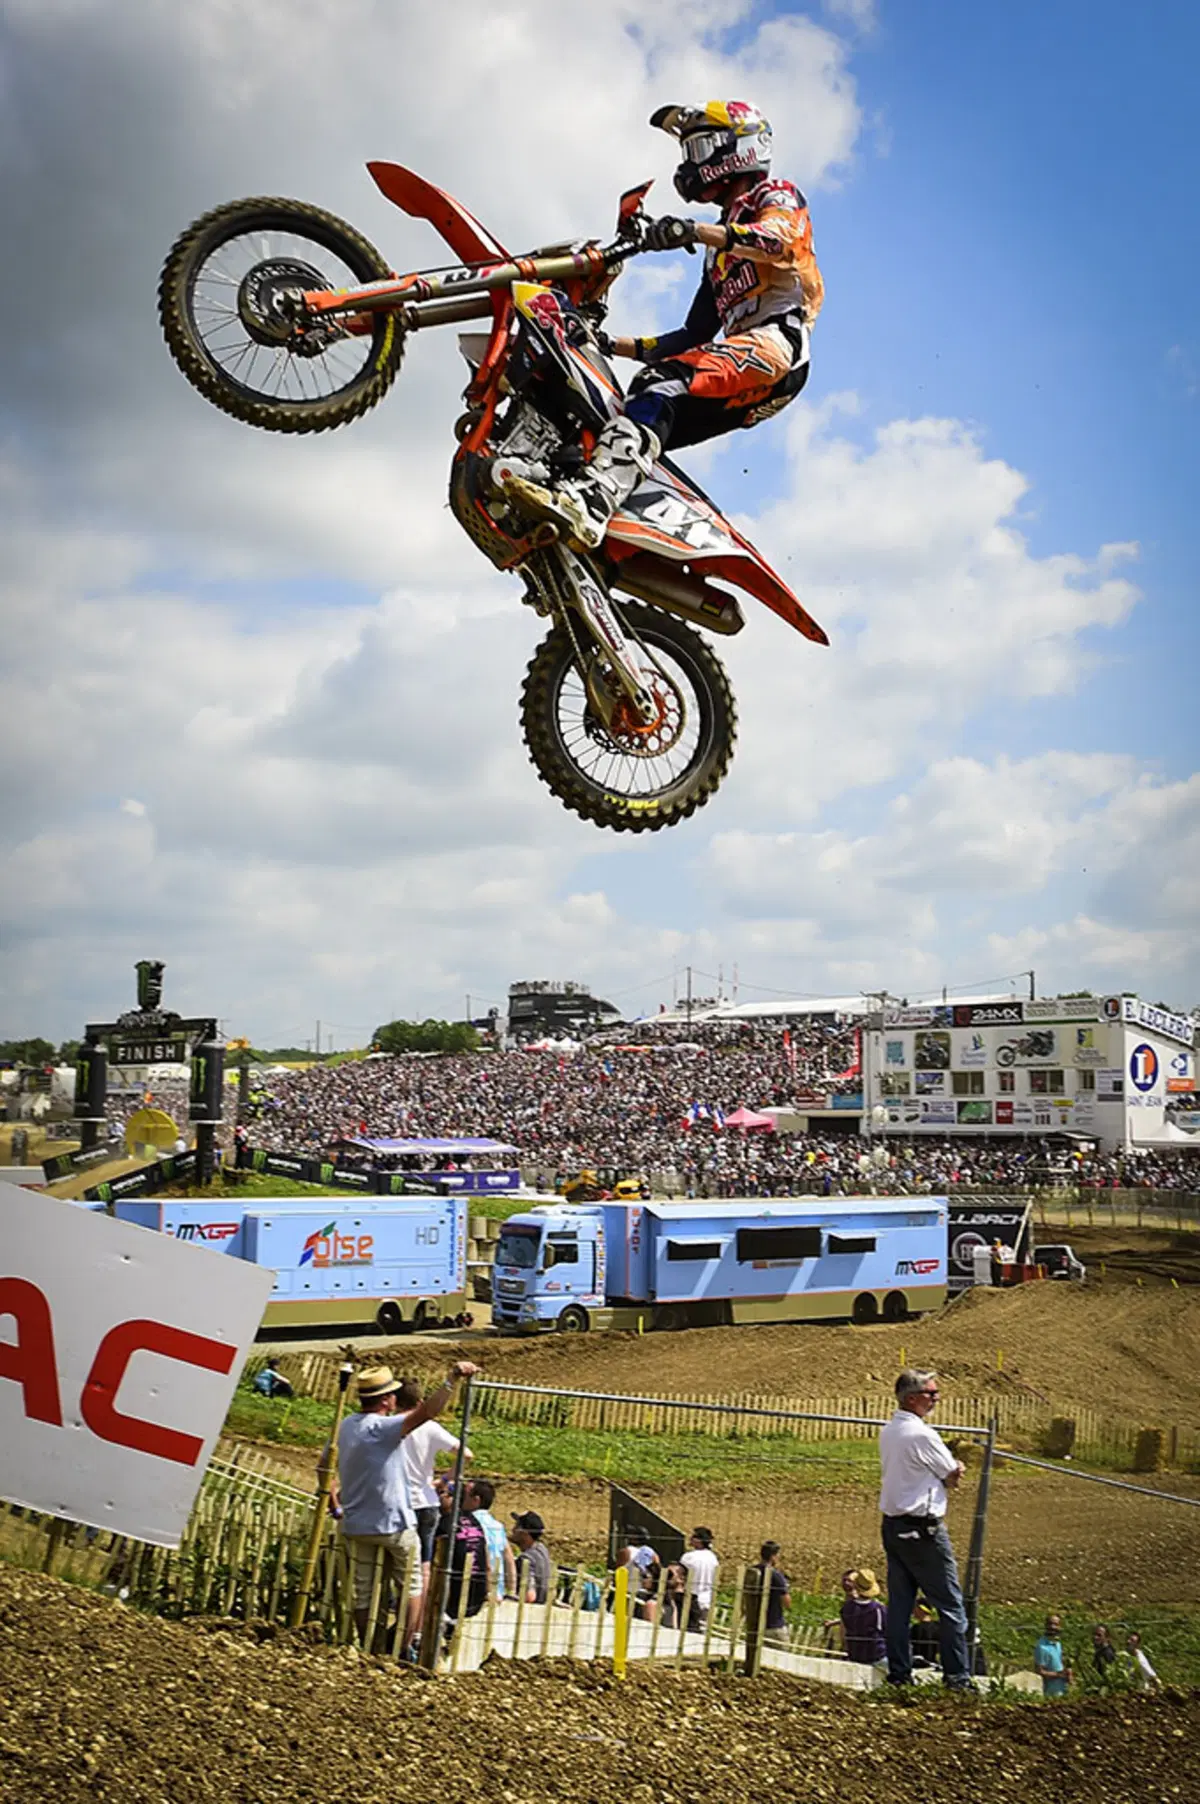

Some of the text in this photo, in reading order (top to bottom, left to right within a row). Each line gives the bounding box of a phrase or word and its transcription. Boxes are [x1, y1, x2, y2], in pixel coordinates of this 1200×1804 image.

[700, 146, 758, 183] Red Bull
[117, 1044, 177, 1061] FINISH
[176, 1222, 240, 1241] MXGP
[415, 1226, 440, 1246] HD
[895, 1259, 941, 1276] MXGP
